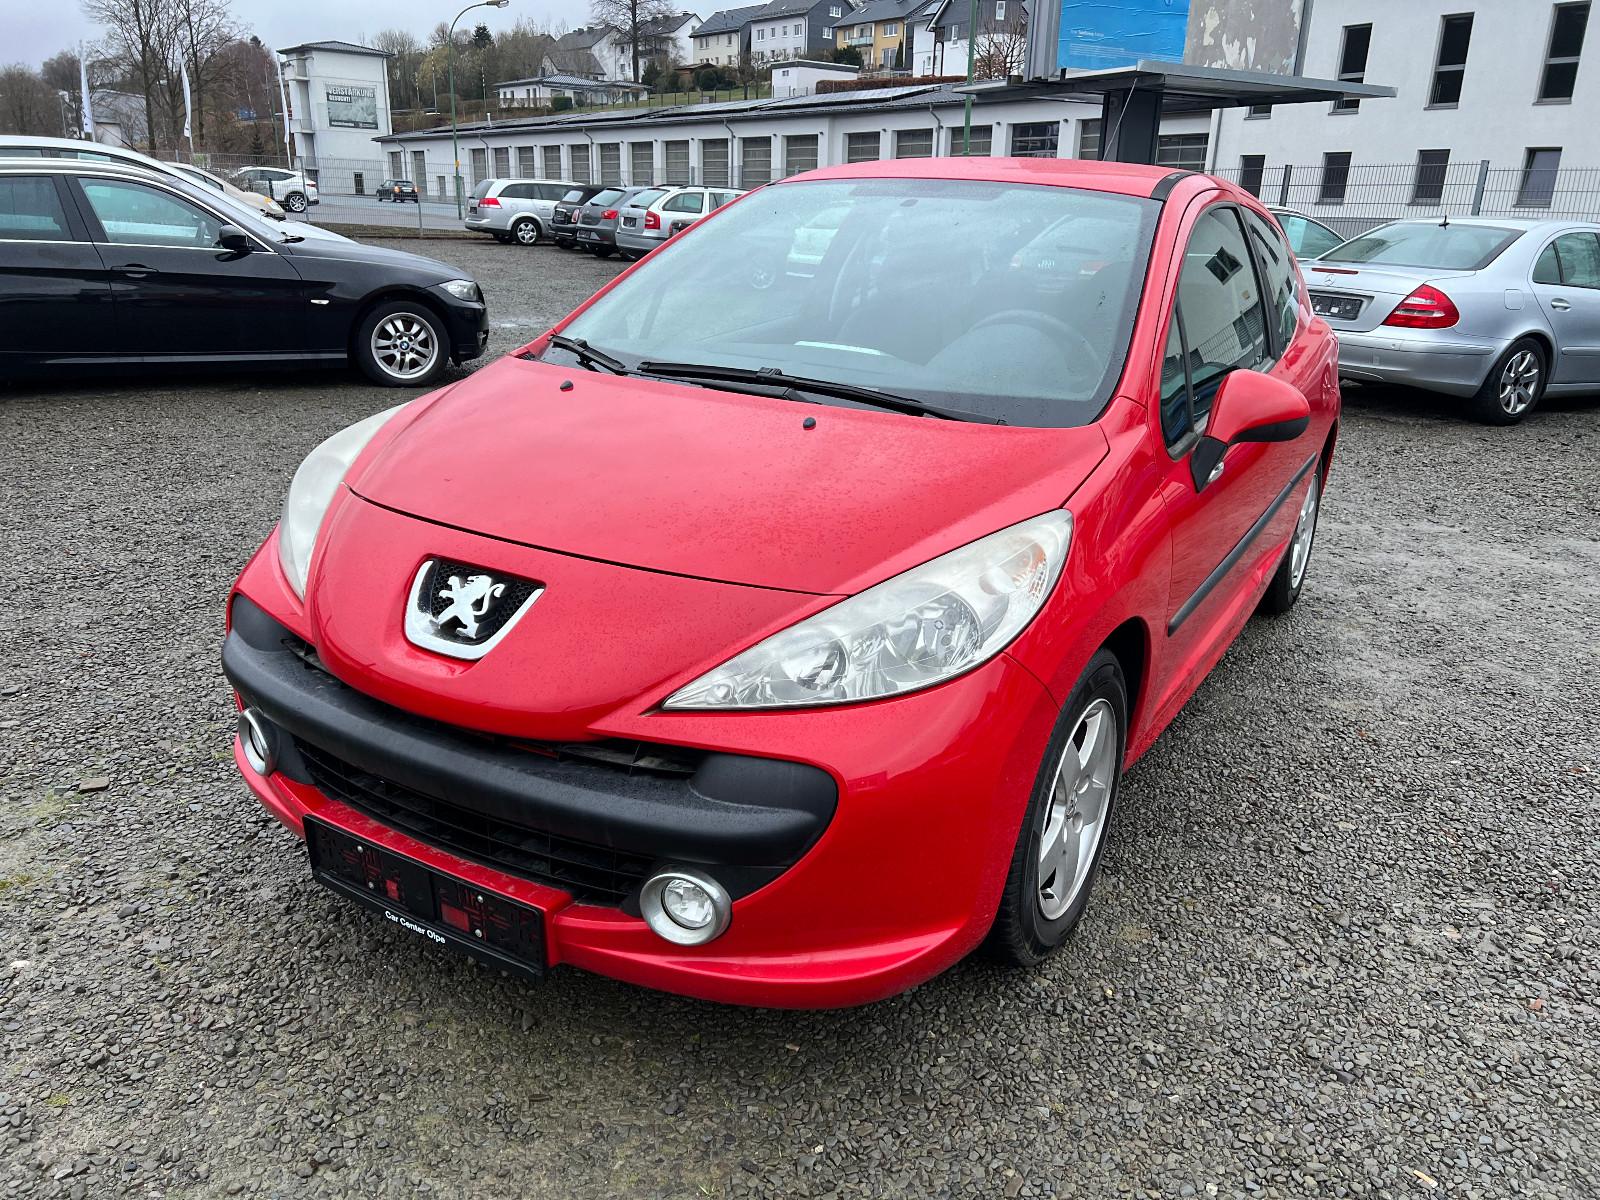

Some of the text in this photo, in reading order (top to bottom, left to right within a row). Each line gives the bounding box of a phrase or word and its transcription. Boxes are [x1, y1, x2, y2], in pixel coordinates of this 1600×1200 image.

[385, 910, 446, 944] Car Center Olpe
